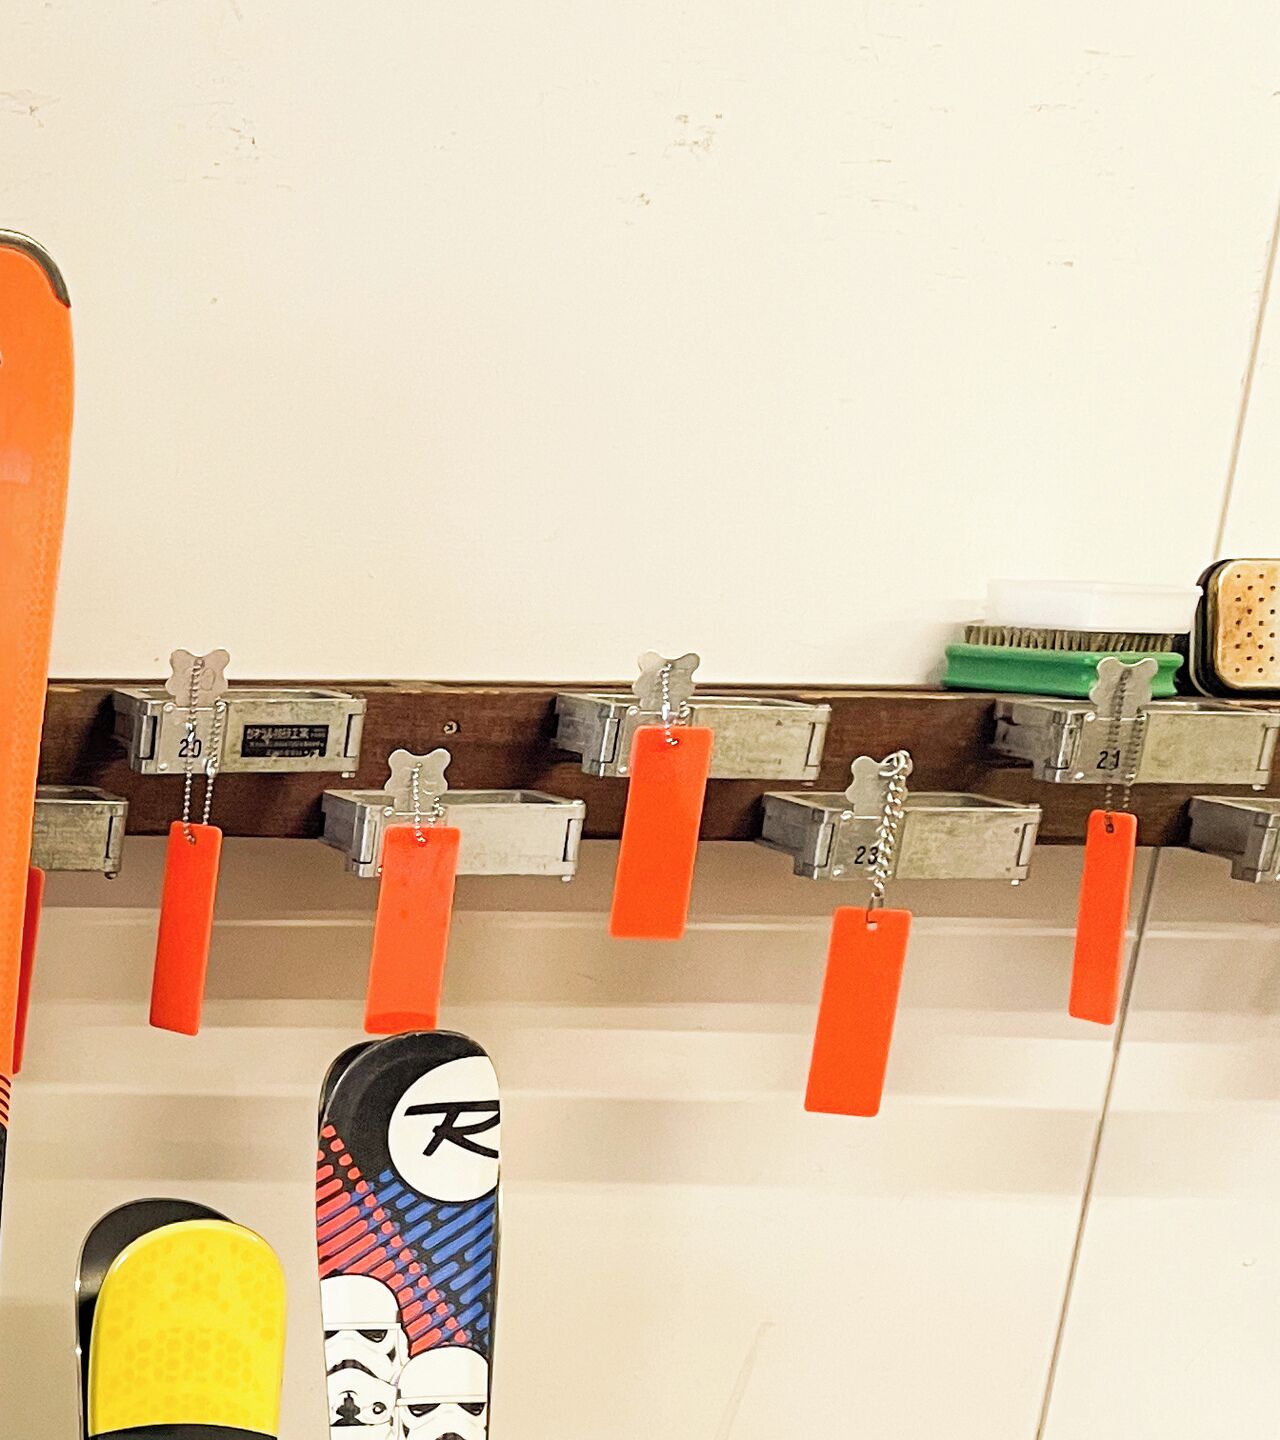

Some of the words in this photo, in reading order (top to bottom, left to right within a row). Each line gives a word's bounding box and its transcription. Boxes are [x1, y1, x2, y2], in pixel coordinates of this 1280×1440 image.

[178, 738, 203, 758] 20
[1096, 750, 1122, 770] 21
[853, 846, 880, 866] 23
